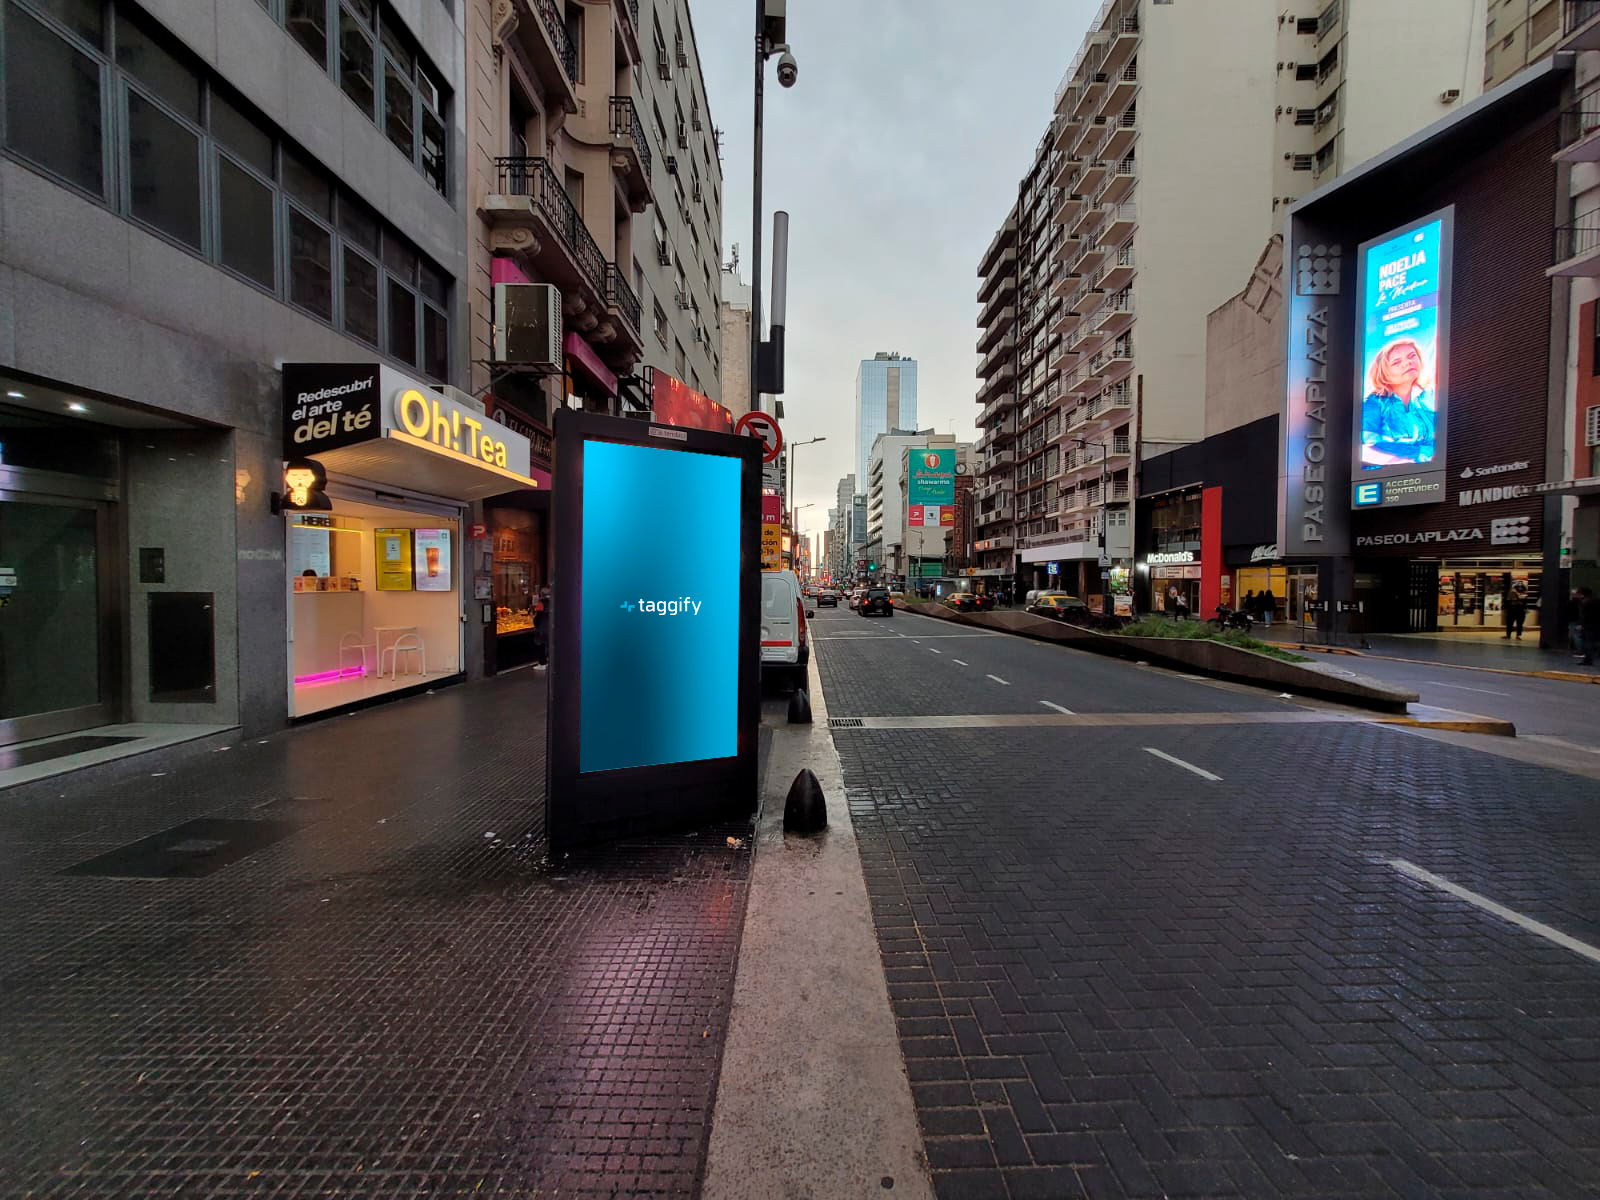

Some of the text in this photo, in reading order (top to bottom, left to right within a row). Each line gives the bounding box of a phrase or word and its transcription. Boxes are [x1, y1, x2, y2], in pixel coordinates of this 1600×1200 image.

[1379, 250, 1427, 279] NOELIA
[1379, 272, 1407, 292] PACE
[297, 375, 374, 405] Redescubrí
[291, 400, 342, 421] el arte
[293, 403, 372, 444] del té
[399, 389, 507, 468] Oh! Tea
[1475, 461, 1530, 476] Santander
[1358, 483, 1440, 503] E MONTEVIDEO
[1386, 478, 1422, 488] ACCESO
[1459, 485, 1529, 507] MANDUC
[761, 537, 778, 546] ción
[1356, 528, 1484, 546] PASEOLAPLAZA
[1147, 551, 1194, 563] McDonald's
[638, 597, 702, 616] taggify
